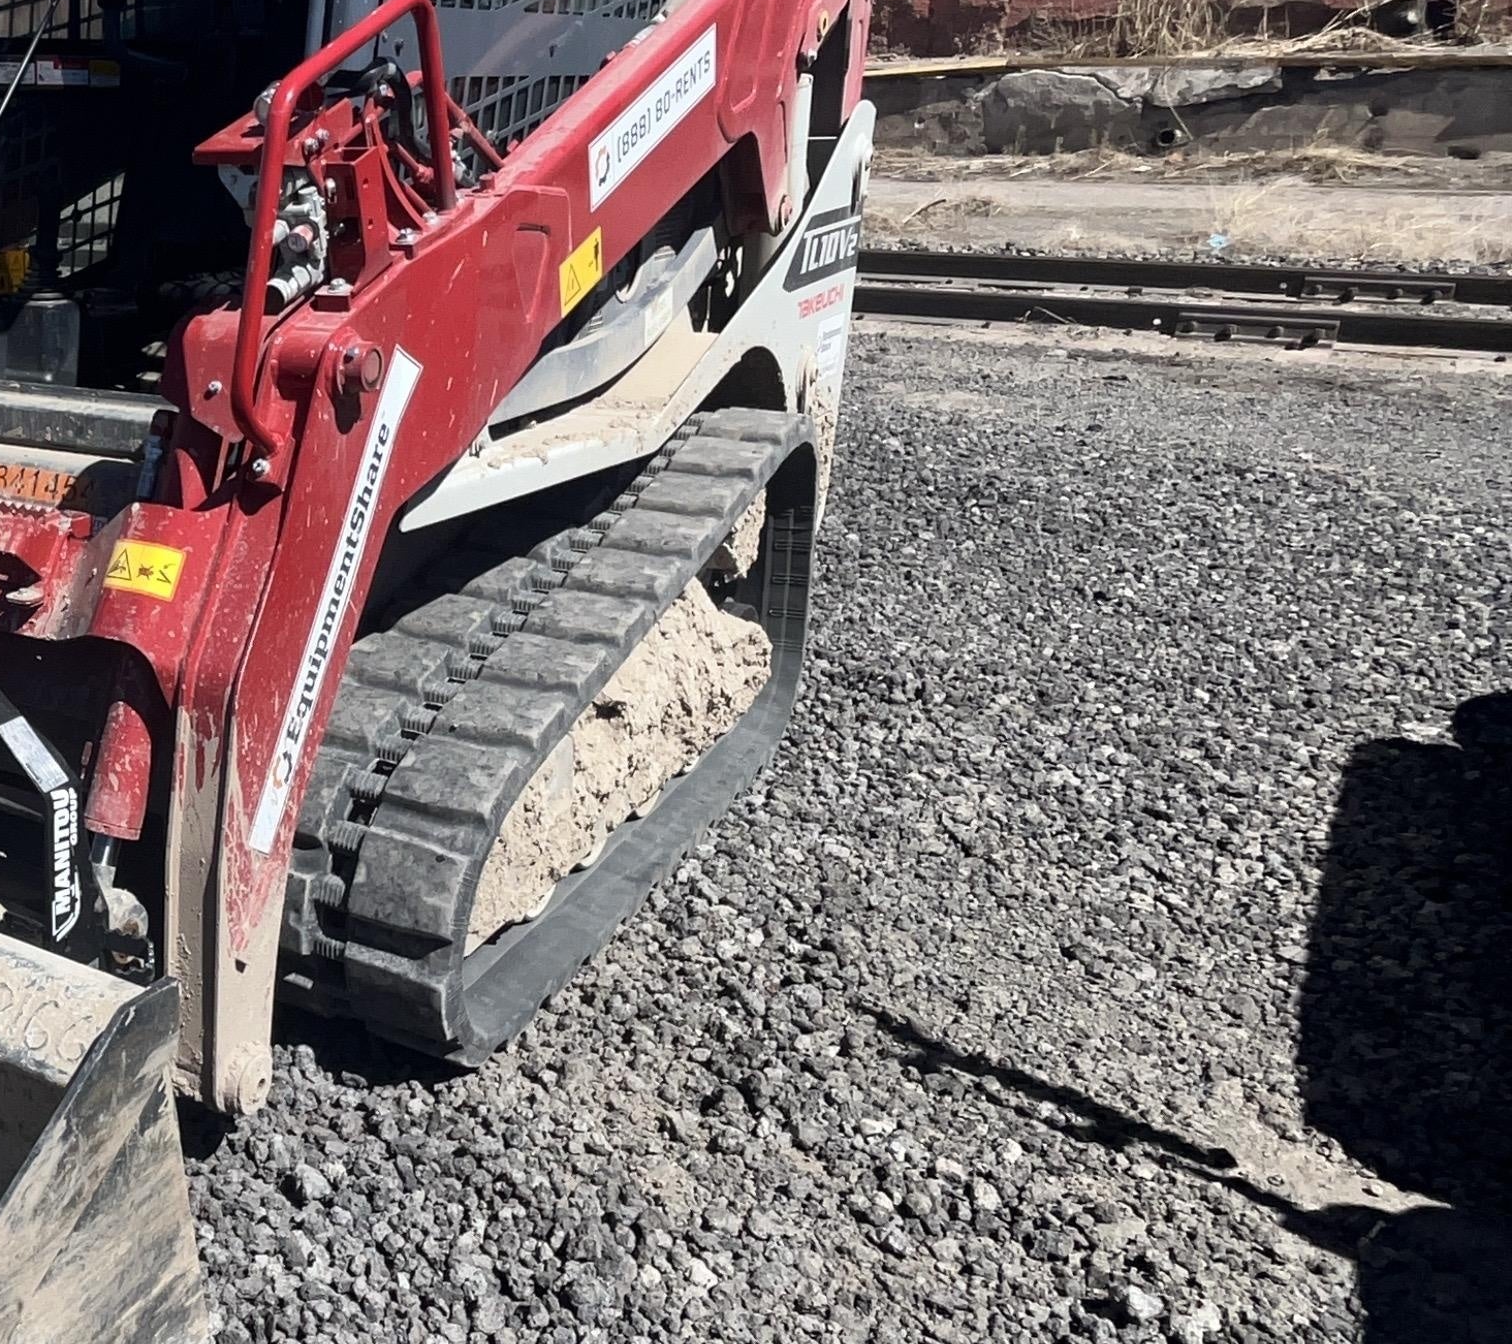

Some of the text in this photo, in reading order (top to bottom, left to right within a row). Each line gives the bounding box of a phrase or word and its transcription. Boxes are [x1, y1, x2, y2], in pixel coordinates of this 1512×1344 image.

[287, 423, 390, 745] EquipmentShare
[50, 788, 71, 916] MANITOU
[68, 787, 78, 846] GROUP
